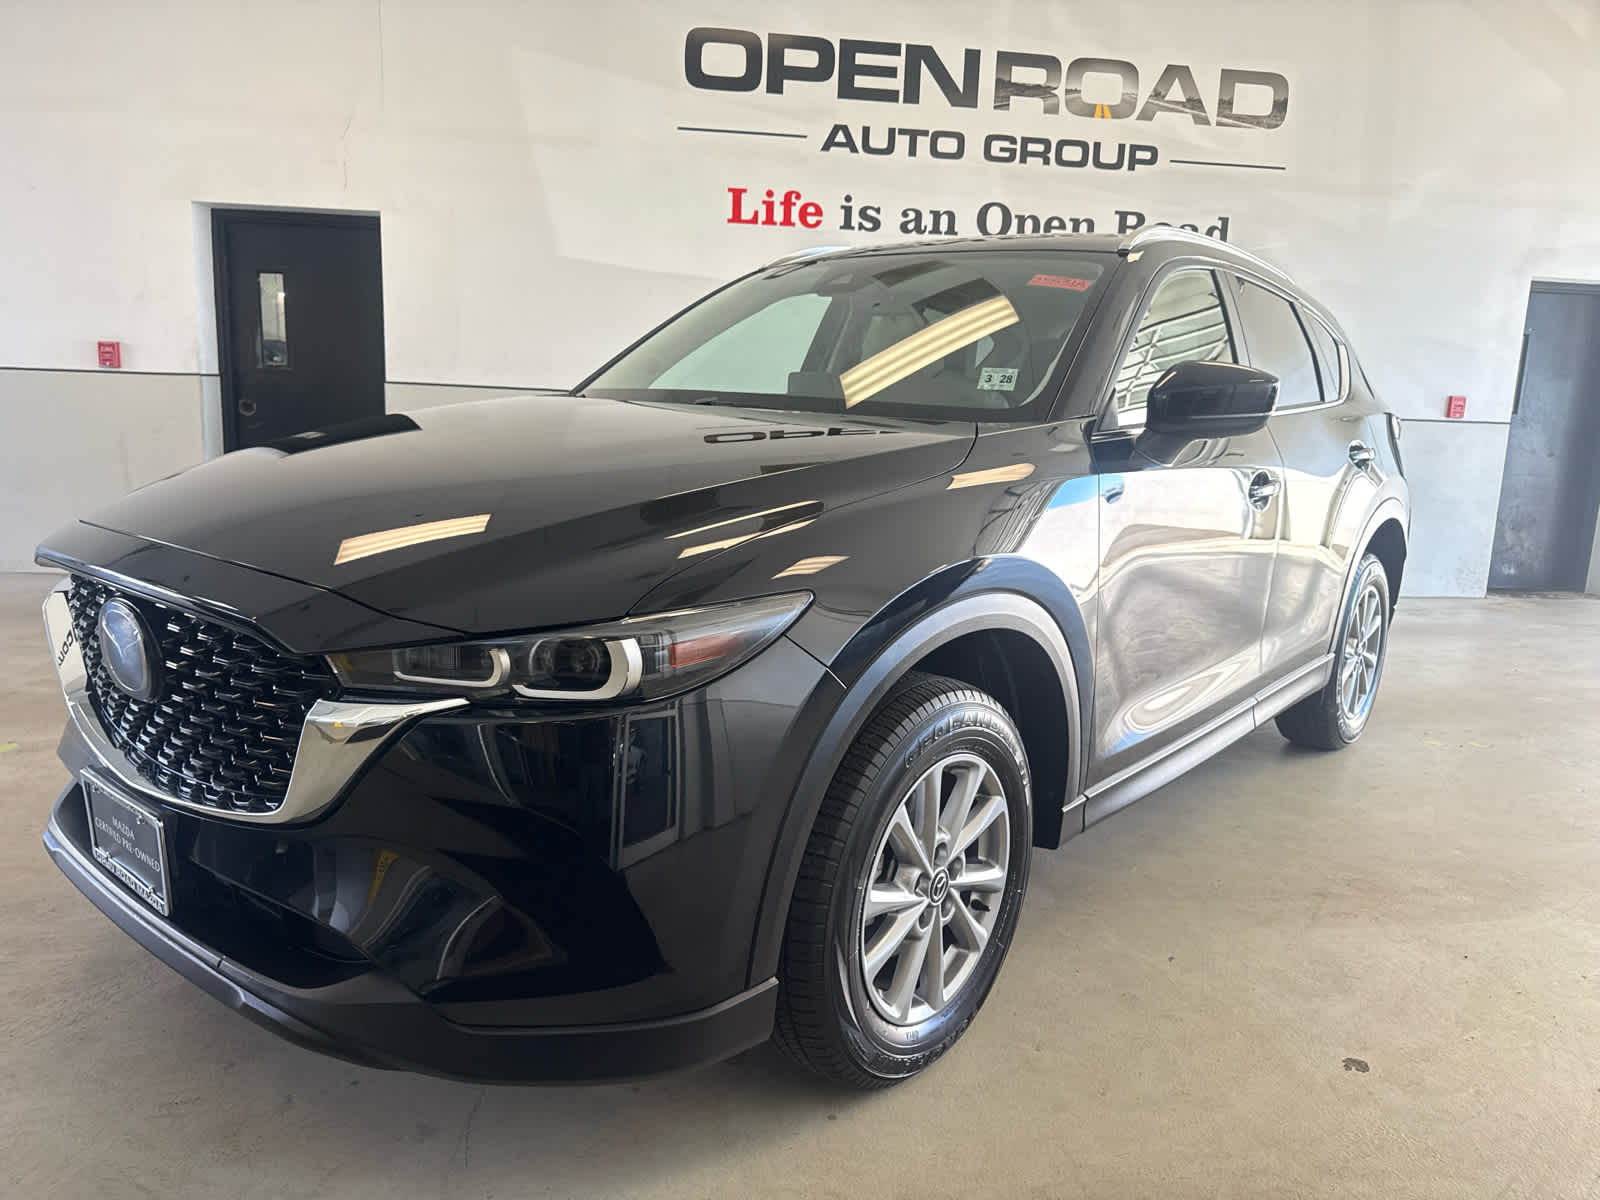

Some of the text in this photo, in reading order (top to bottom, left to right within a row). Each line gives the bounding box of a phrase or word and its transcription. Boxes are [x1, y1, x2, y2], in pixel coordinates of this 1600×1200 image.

[684, 27, 1289, 130] OPEN ROAD
[820, 124, 1159, 171] AUTO GROUP
[727, 187, 824, 229] Life
[839, 195, 882, 232] is
[899, 208, 958, 236] an
[1114, 209, 1230, 243] Rd
[984, 374, 1013, 384] 3 28
[112, 816, 135, 840] MAZDA
[122, 837, 160, 872] PRE-OWNED
